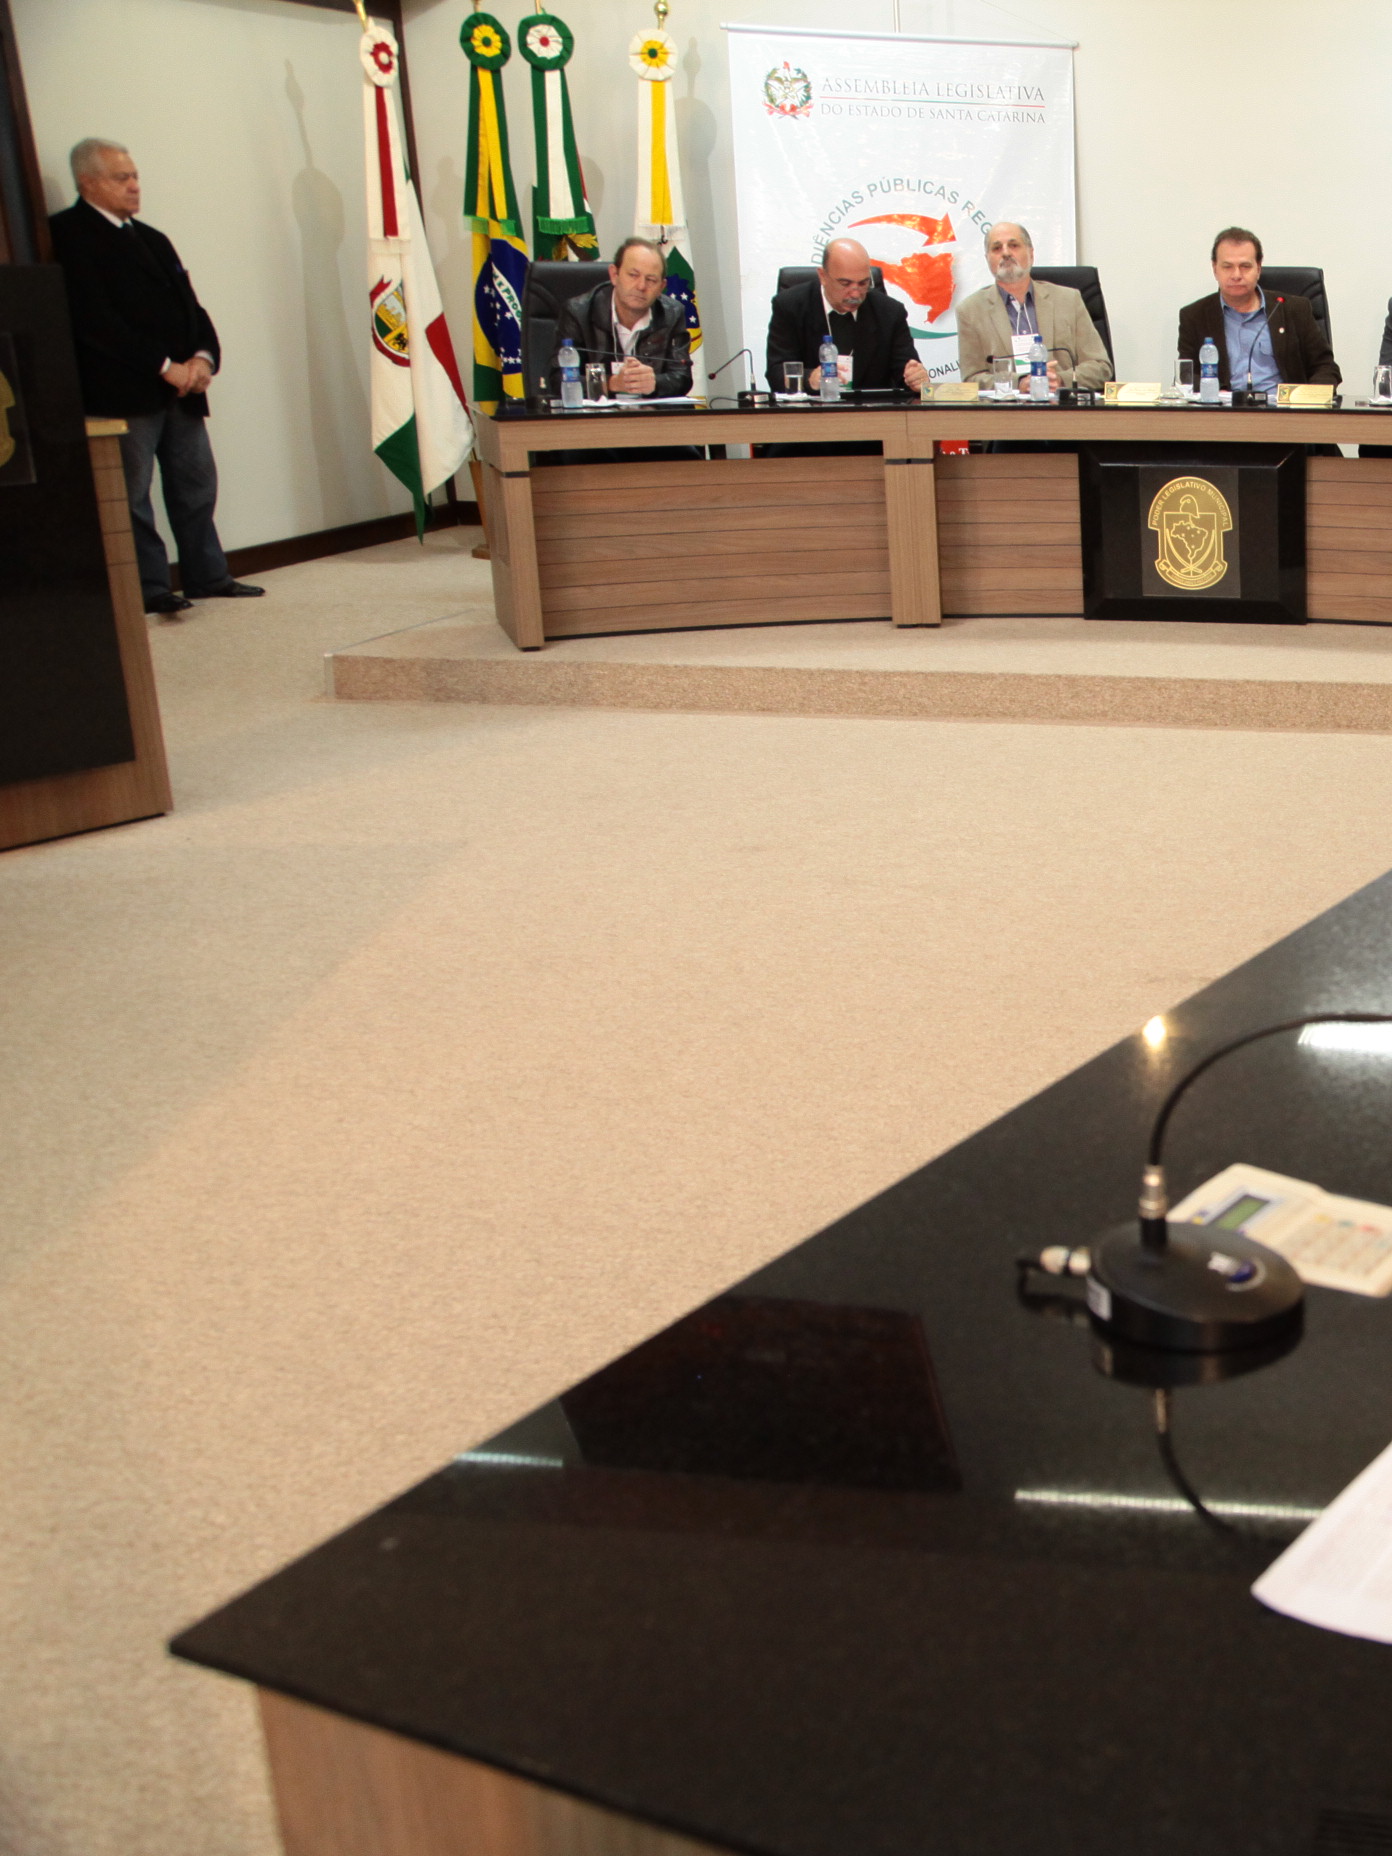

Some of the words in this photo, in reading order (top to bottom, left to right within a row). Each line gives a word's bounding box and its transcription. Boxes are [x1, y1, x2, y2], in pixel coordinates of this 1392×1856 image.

[821, 77, 930, 96] ASSEMBLEIA
[936, 82, 1045, 101] LEGISLATIVA
[820, 103, 843, 116] DO
[848, 104, 902, 118] ESTADO
[907, 106, 925, 119] DE
[929, 108, 973, 121] SANTA
[977, 110, 1046, 124] CATARINA
[811, 190, 864, 265] DIÊNCIAS
[867, 176, 960, 205] PÚBLICAS
[961, 200, 993, 236] REG
[928, 360, 960, 379] ONALI
[1152, 499, 1165, 526] PODER
[1162, 481, 1207, 500] LEGISLATIVO
[1207, 488, 1229, 527] MUNICIPAL
